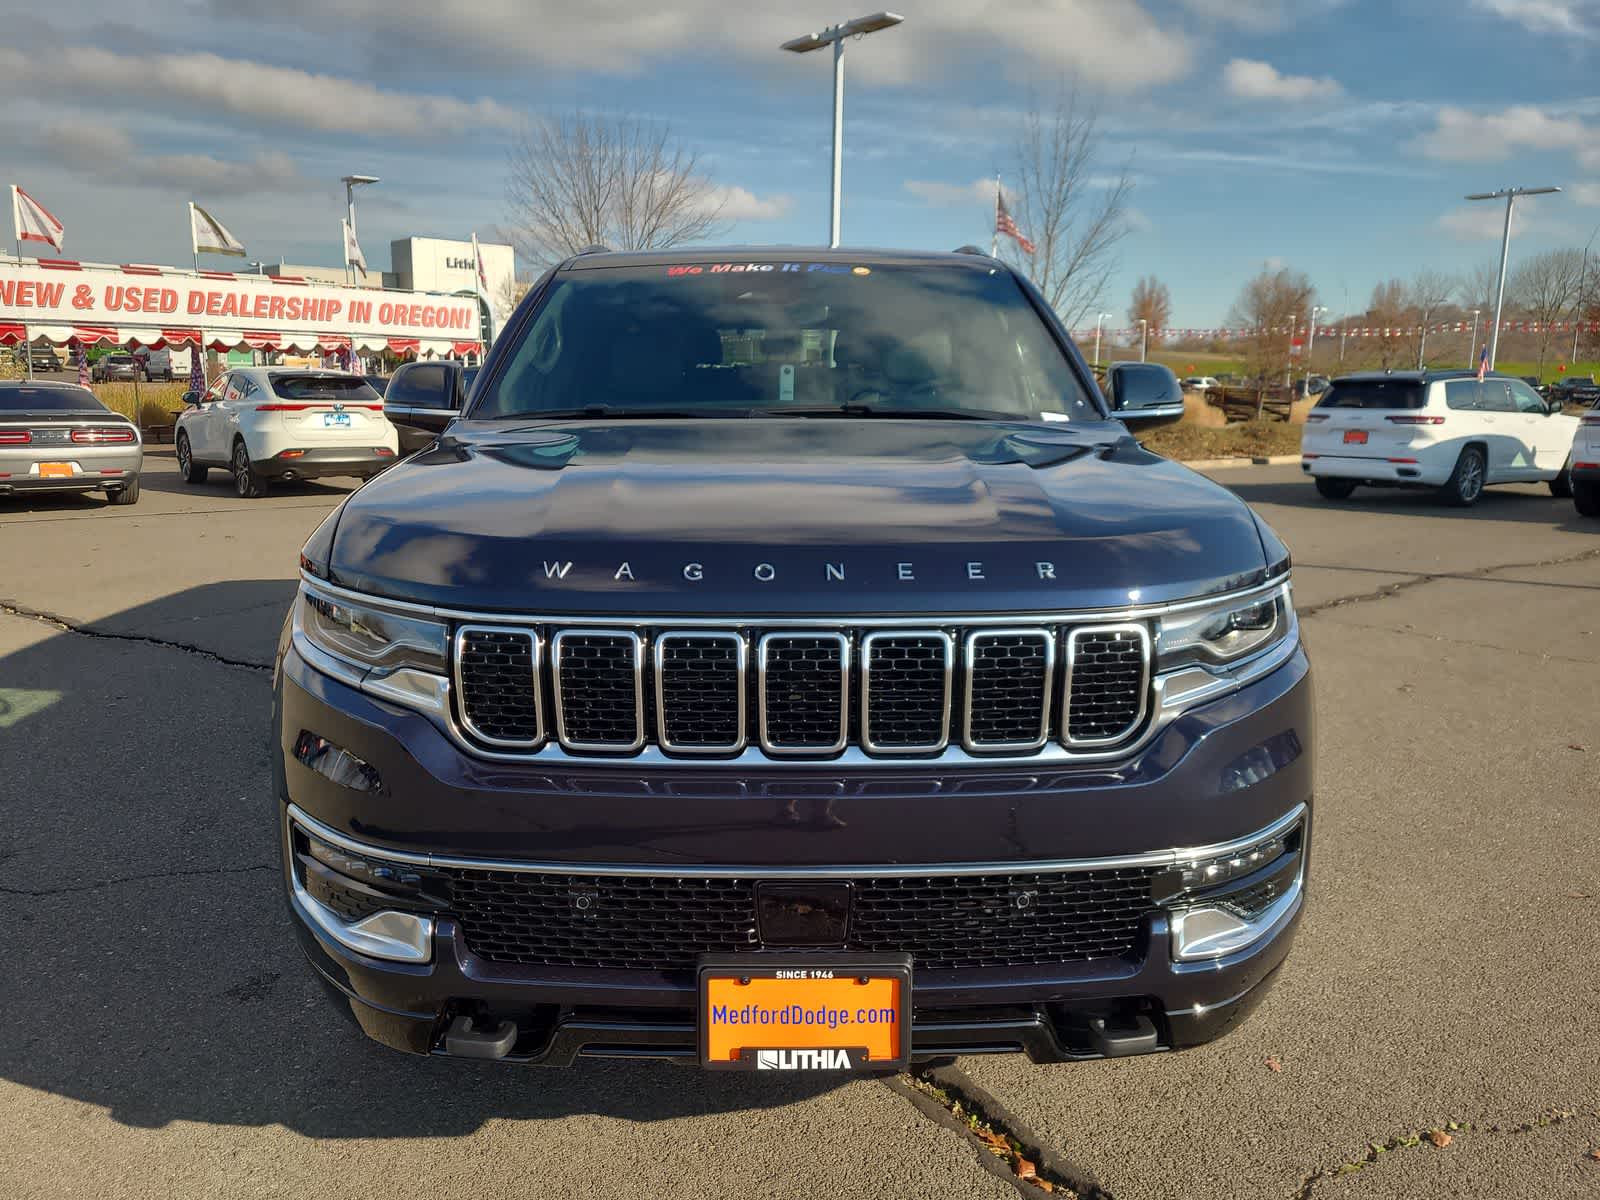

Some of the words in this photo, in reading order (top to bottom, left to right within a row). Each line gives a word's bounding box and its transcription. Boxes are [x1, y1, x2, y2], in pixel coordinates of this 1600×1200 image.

[446, 256, 477, 270] Lithi
[668, 265, 703, 278] We
[709, 263, 775, 273] Make
[781, 263, 801, 272] It
[0, 279, 65, 308] NEW
[71, 284, 96, 310] &
[104, 285, 179, 314] USED
[186, 290, 342, 322] DEALERSHIP
[347, 300, 373, 323] IN
[378, 303, 473, 330] OREGON!
[543, 561, 1057, 581] WAGONEER
[775, 970, 808, 979] SINCE
[810, 970, 834, 979] 1946
[712, 1005, 896, 1029] MedfordDodge.com
[778, 1050, 852, 1070] LITHIA
